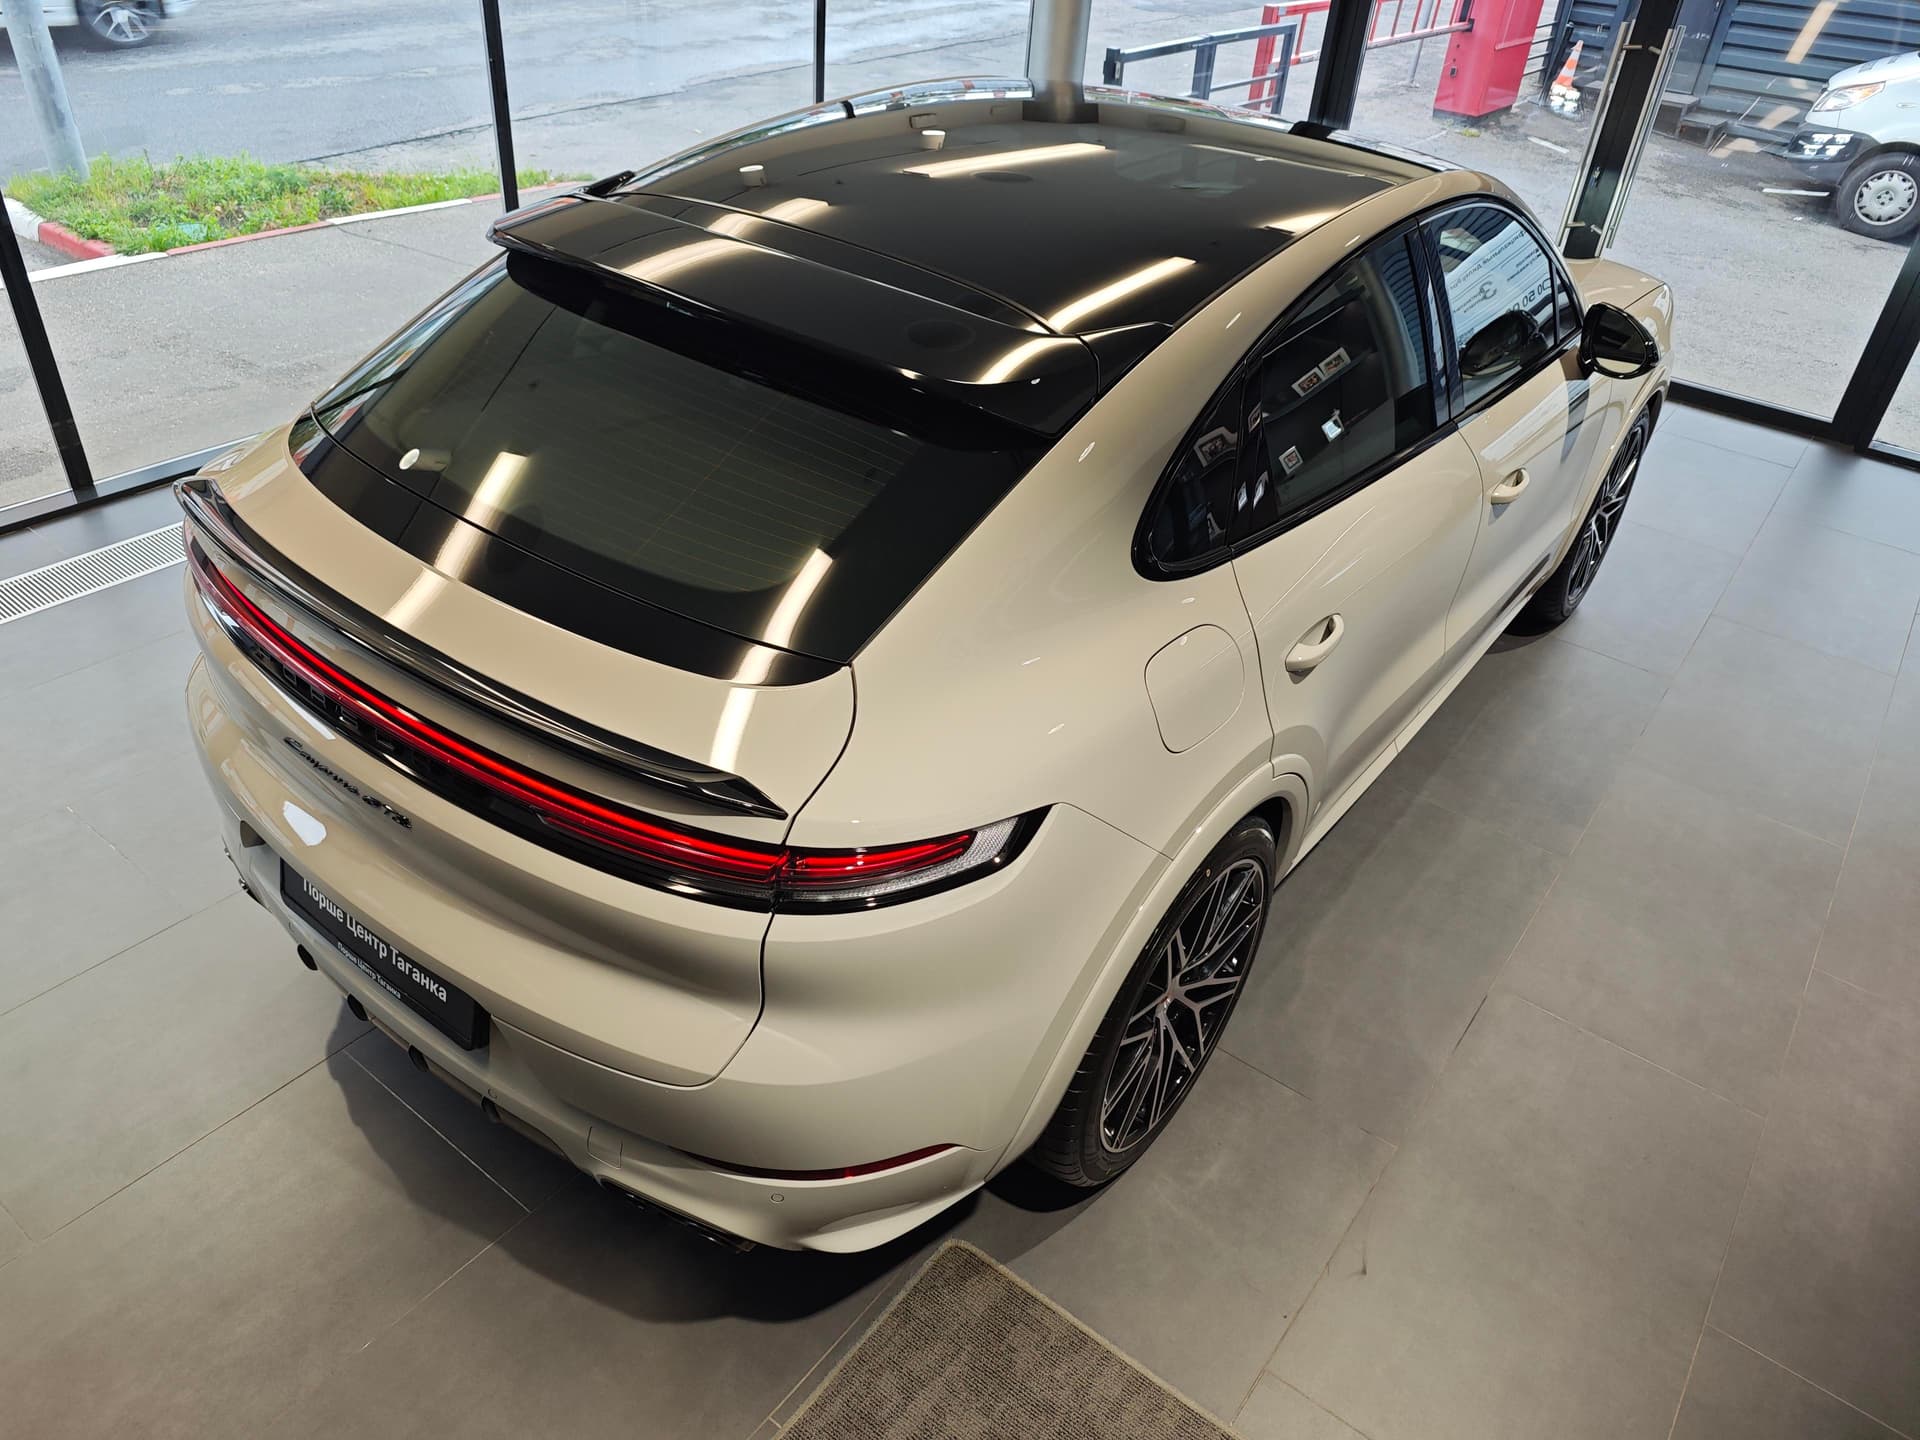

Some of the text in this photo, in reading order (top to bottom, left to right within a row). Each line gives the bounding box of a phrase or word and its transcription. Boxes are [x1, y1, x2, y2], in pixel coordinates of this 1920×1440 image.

[284, 736, 360, 797] Cayenne
[303, 879, 447, 1003] Порше Центр Таганка
[376, 972, 401, 999] Таганка
